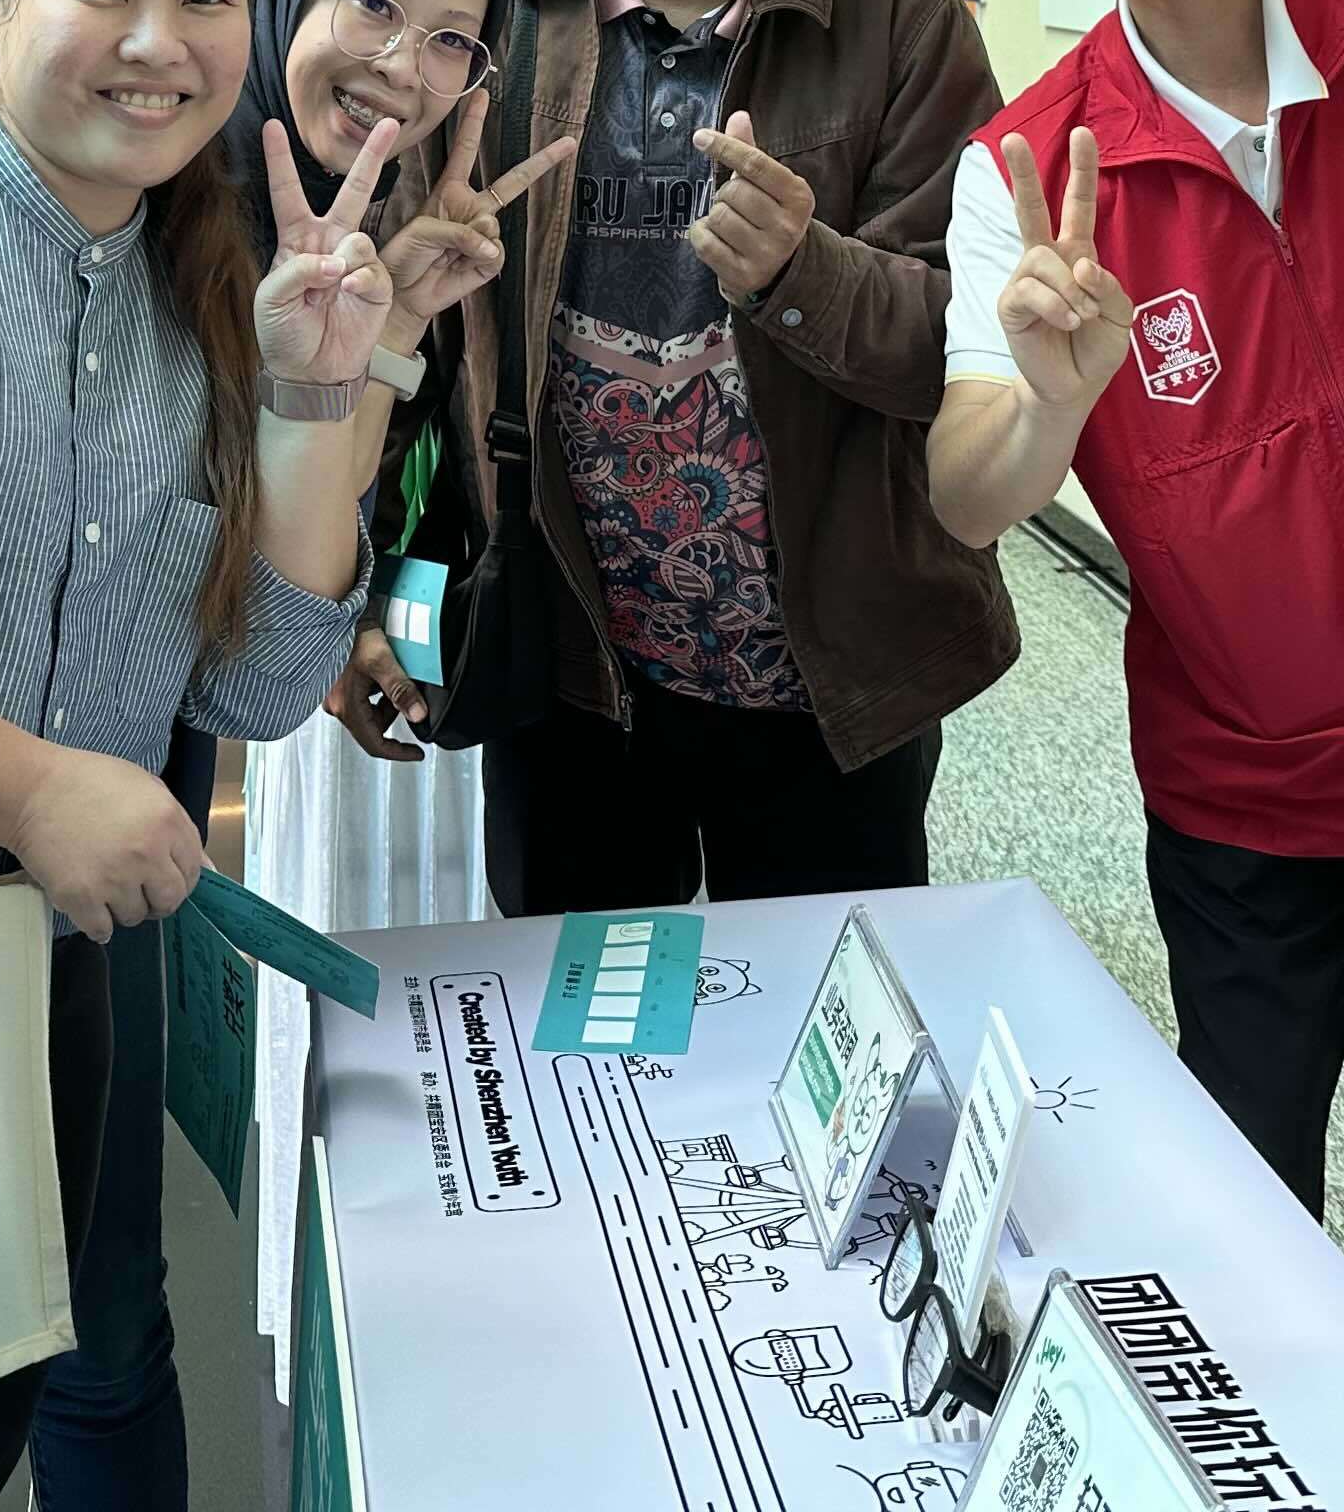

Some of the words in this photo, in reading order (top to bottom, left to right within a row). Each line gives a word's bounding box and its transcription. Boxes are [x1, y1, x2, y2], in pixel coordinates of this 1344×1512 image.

[586, 226, 666, 239] ASPIRASI
[1153, 360, 1213, 393] 宝安义工
[457, 991, 496, 1045] Created
[465, 1047, 497, 1067] by
[473, 1068, 513, 1145] Shenzhen
[490, 1144, 529, 1188] Youth
[1074, 1272, 1330, 1512] 团团带你玩
